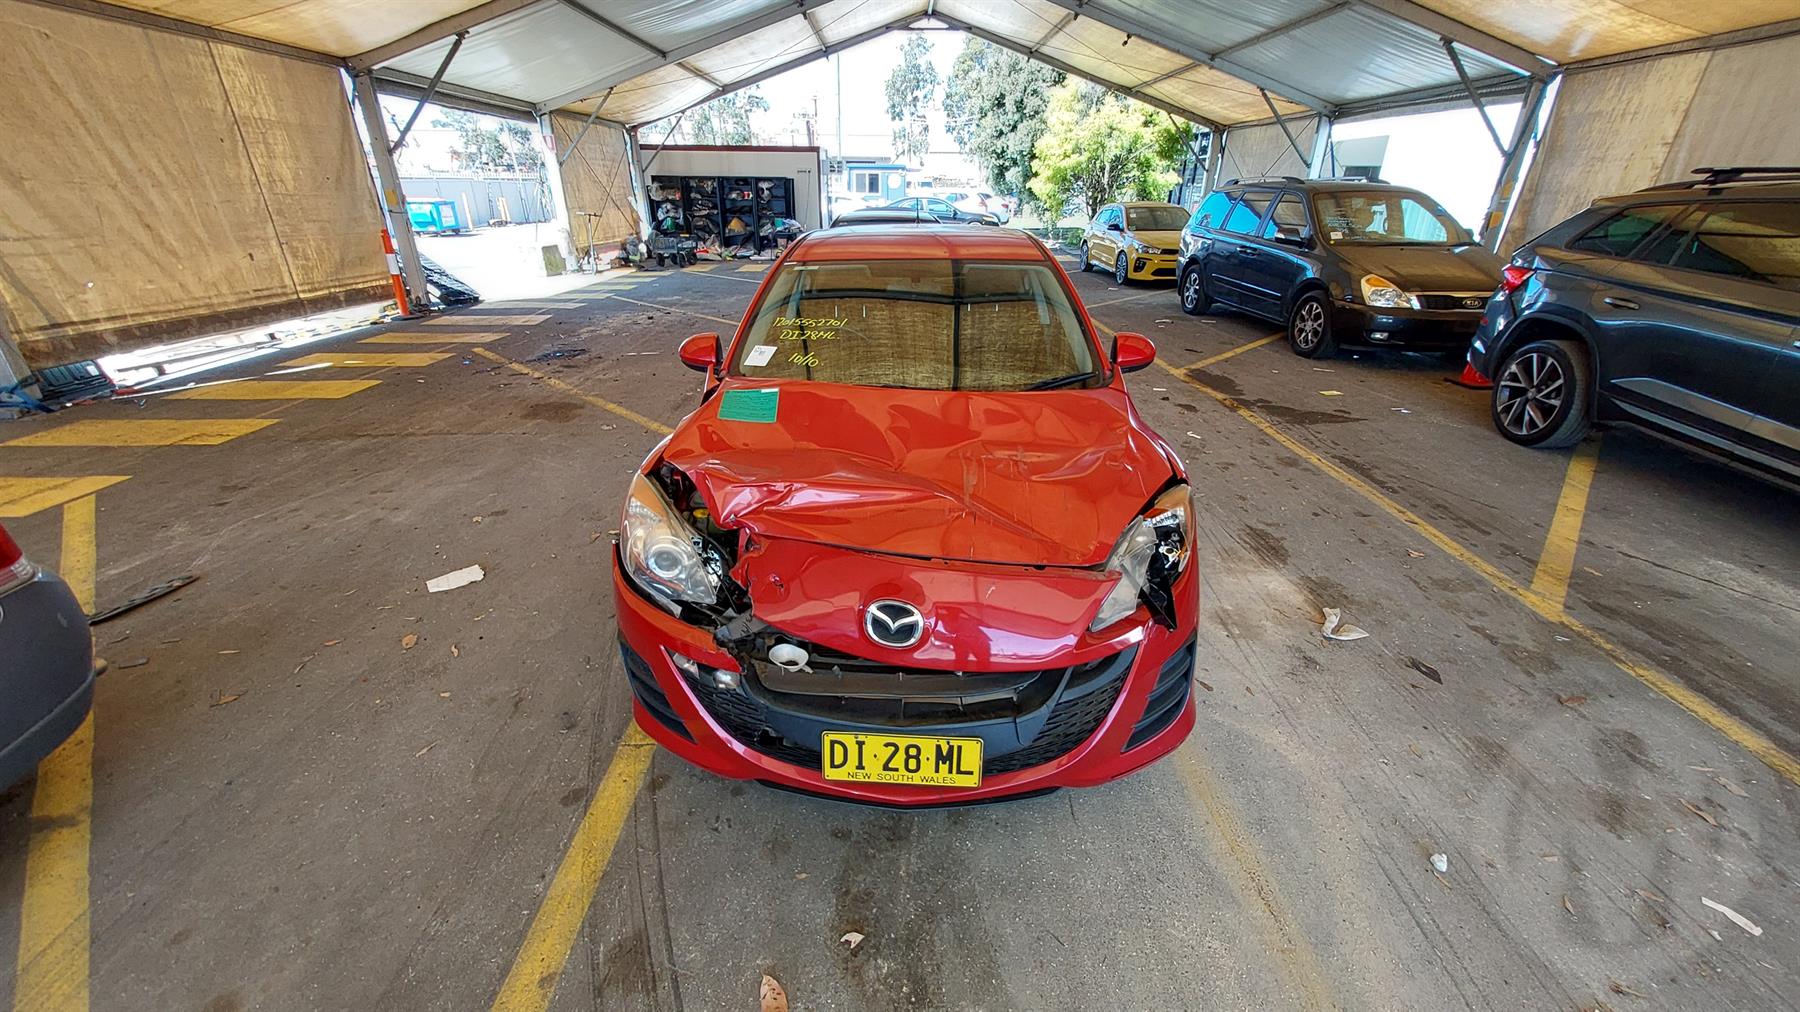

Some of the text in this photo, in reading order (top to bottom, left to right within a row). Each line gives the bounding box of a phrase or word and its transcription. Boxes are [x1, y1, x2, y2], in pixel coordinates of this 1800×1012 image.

[847, 771, 956, 785] NEW SOUTH WALES
